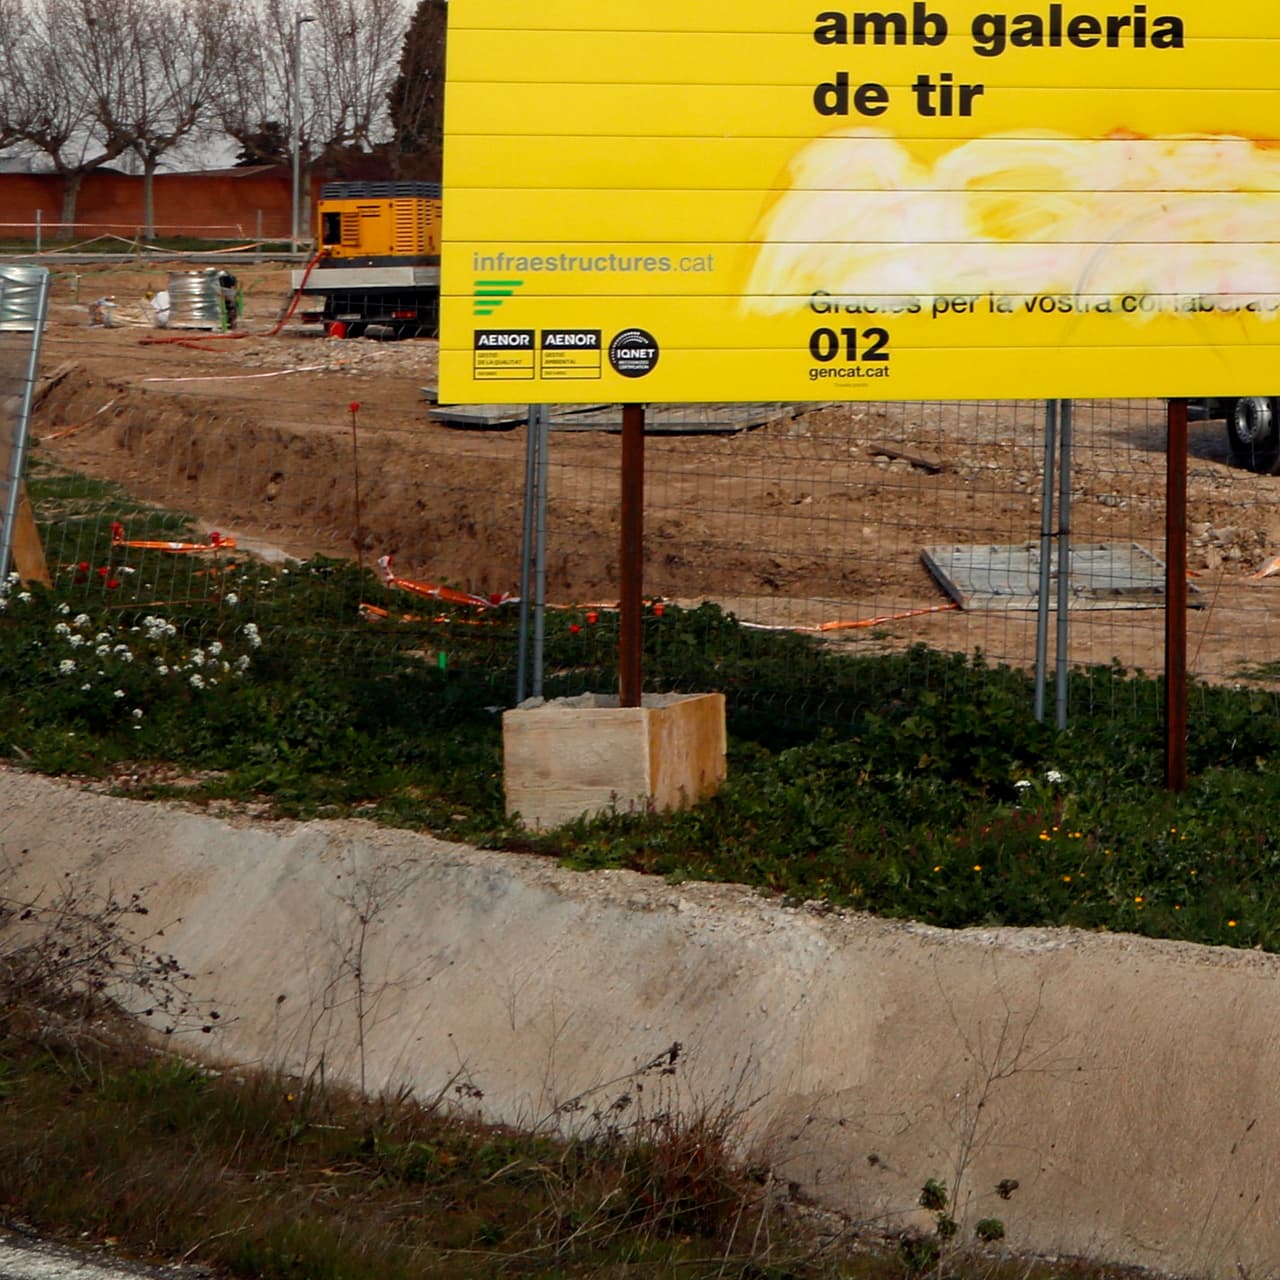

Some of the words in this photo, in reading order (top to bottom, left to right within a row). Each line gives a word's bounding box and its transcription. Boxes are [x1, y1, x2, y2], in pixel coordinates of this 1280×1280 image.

[813, 2, 948, 47] amb
[971, 5, 1185, 56] galeria
[813, 71, 893, 116] de
[911, 74, 984, 117] tir
[472, 252, 714, 272] infraestructures.cat
[932, 294, 981, 319] per
[989, 292, 1012, 313] la
[1024, 294, 1113, 313] vostra
[477, 334, 530, 346] AENOR
[545, 334, 597, 346] AENOR
[808, 327, 890, 362] 012
[617, 349, 656, 359] IQNET
[809, 365, 890, 380] gencat.cat
